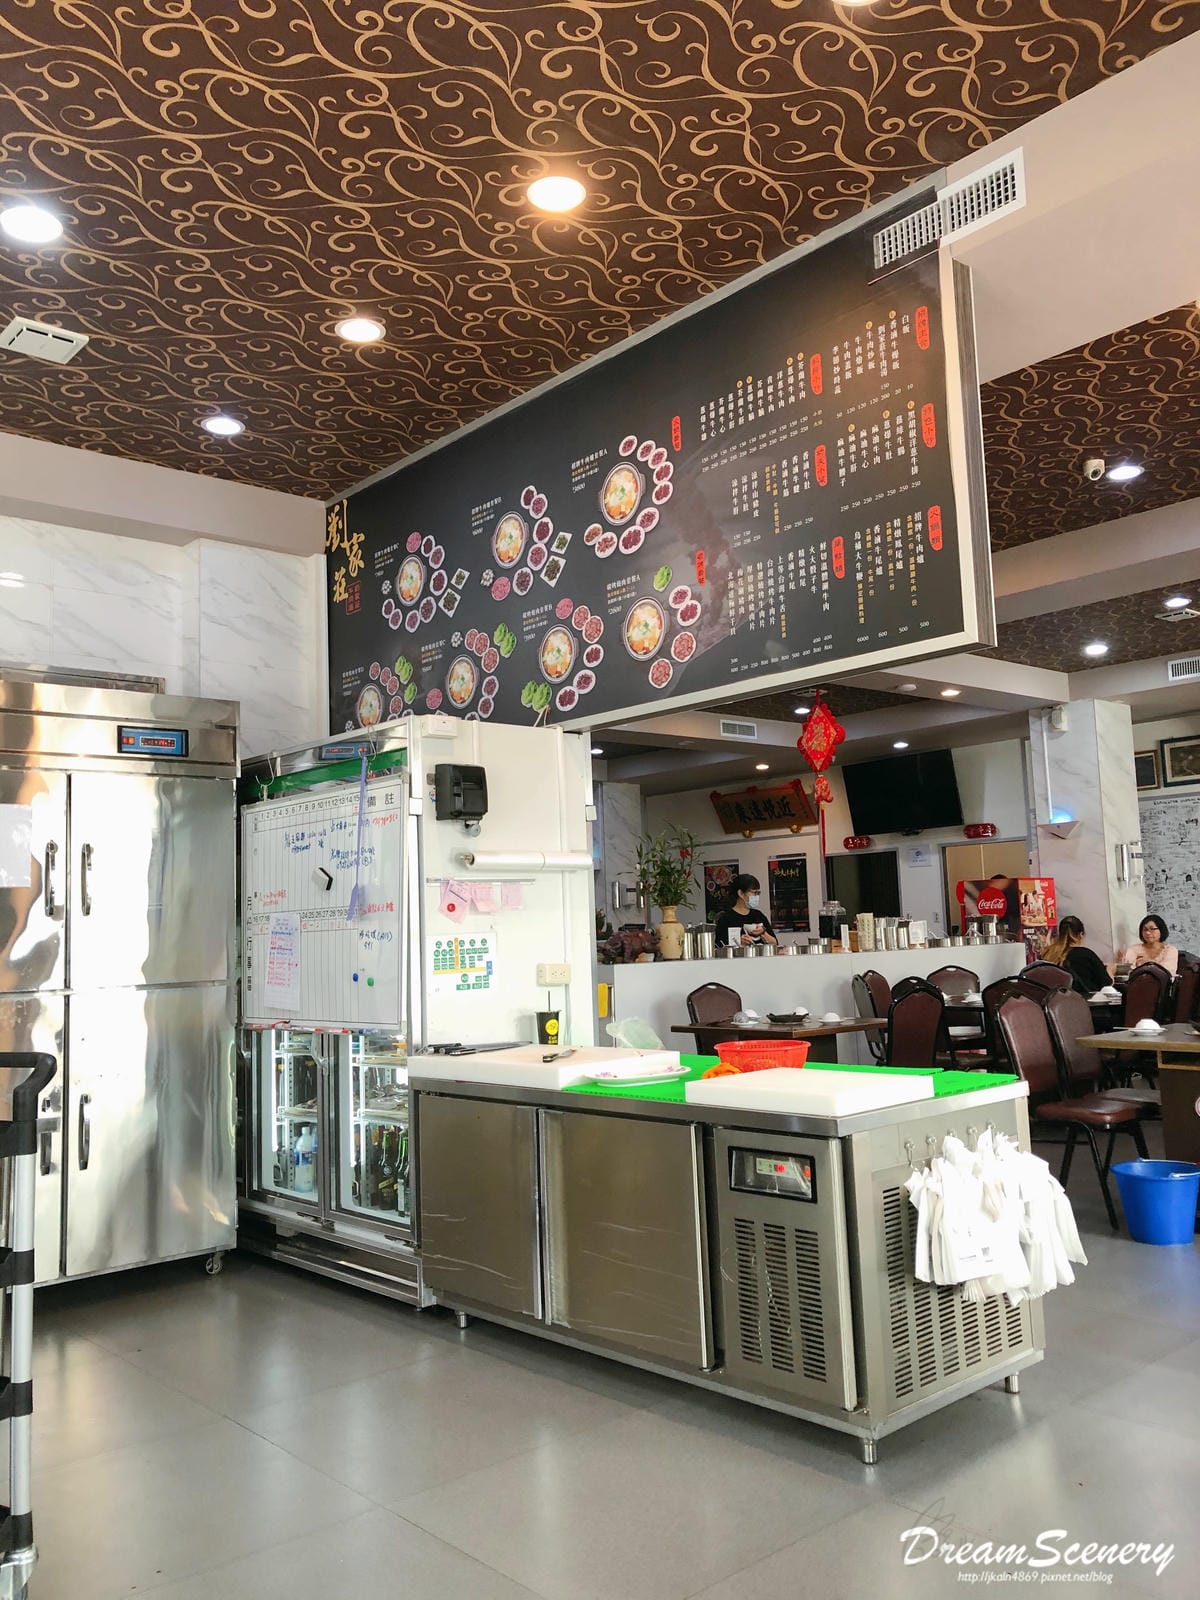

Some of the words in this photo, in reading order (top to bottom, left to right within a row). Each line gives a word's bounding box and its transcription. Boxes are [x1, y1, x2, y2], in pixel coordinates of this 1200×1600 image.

[914, 511, 924, 564] 招牌牛肉爐
[384, 793, 395, 805] 註
[978, 898, 1005, 911] Coca-Cola
